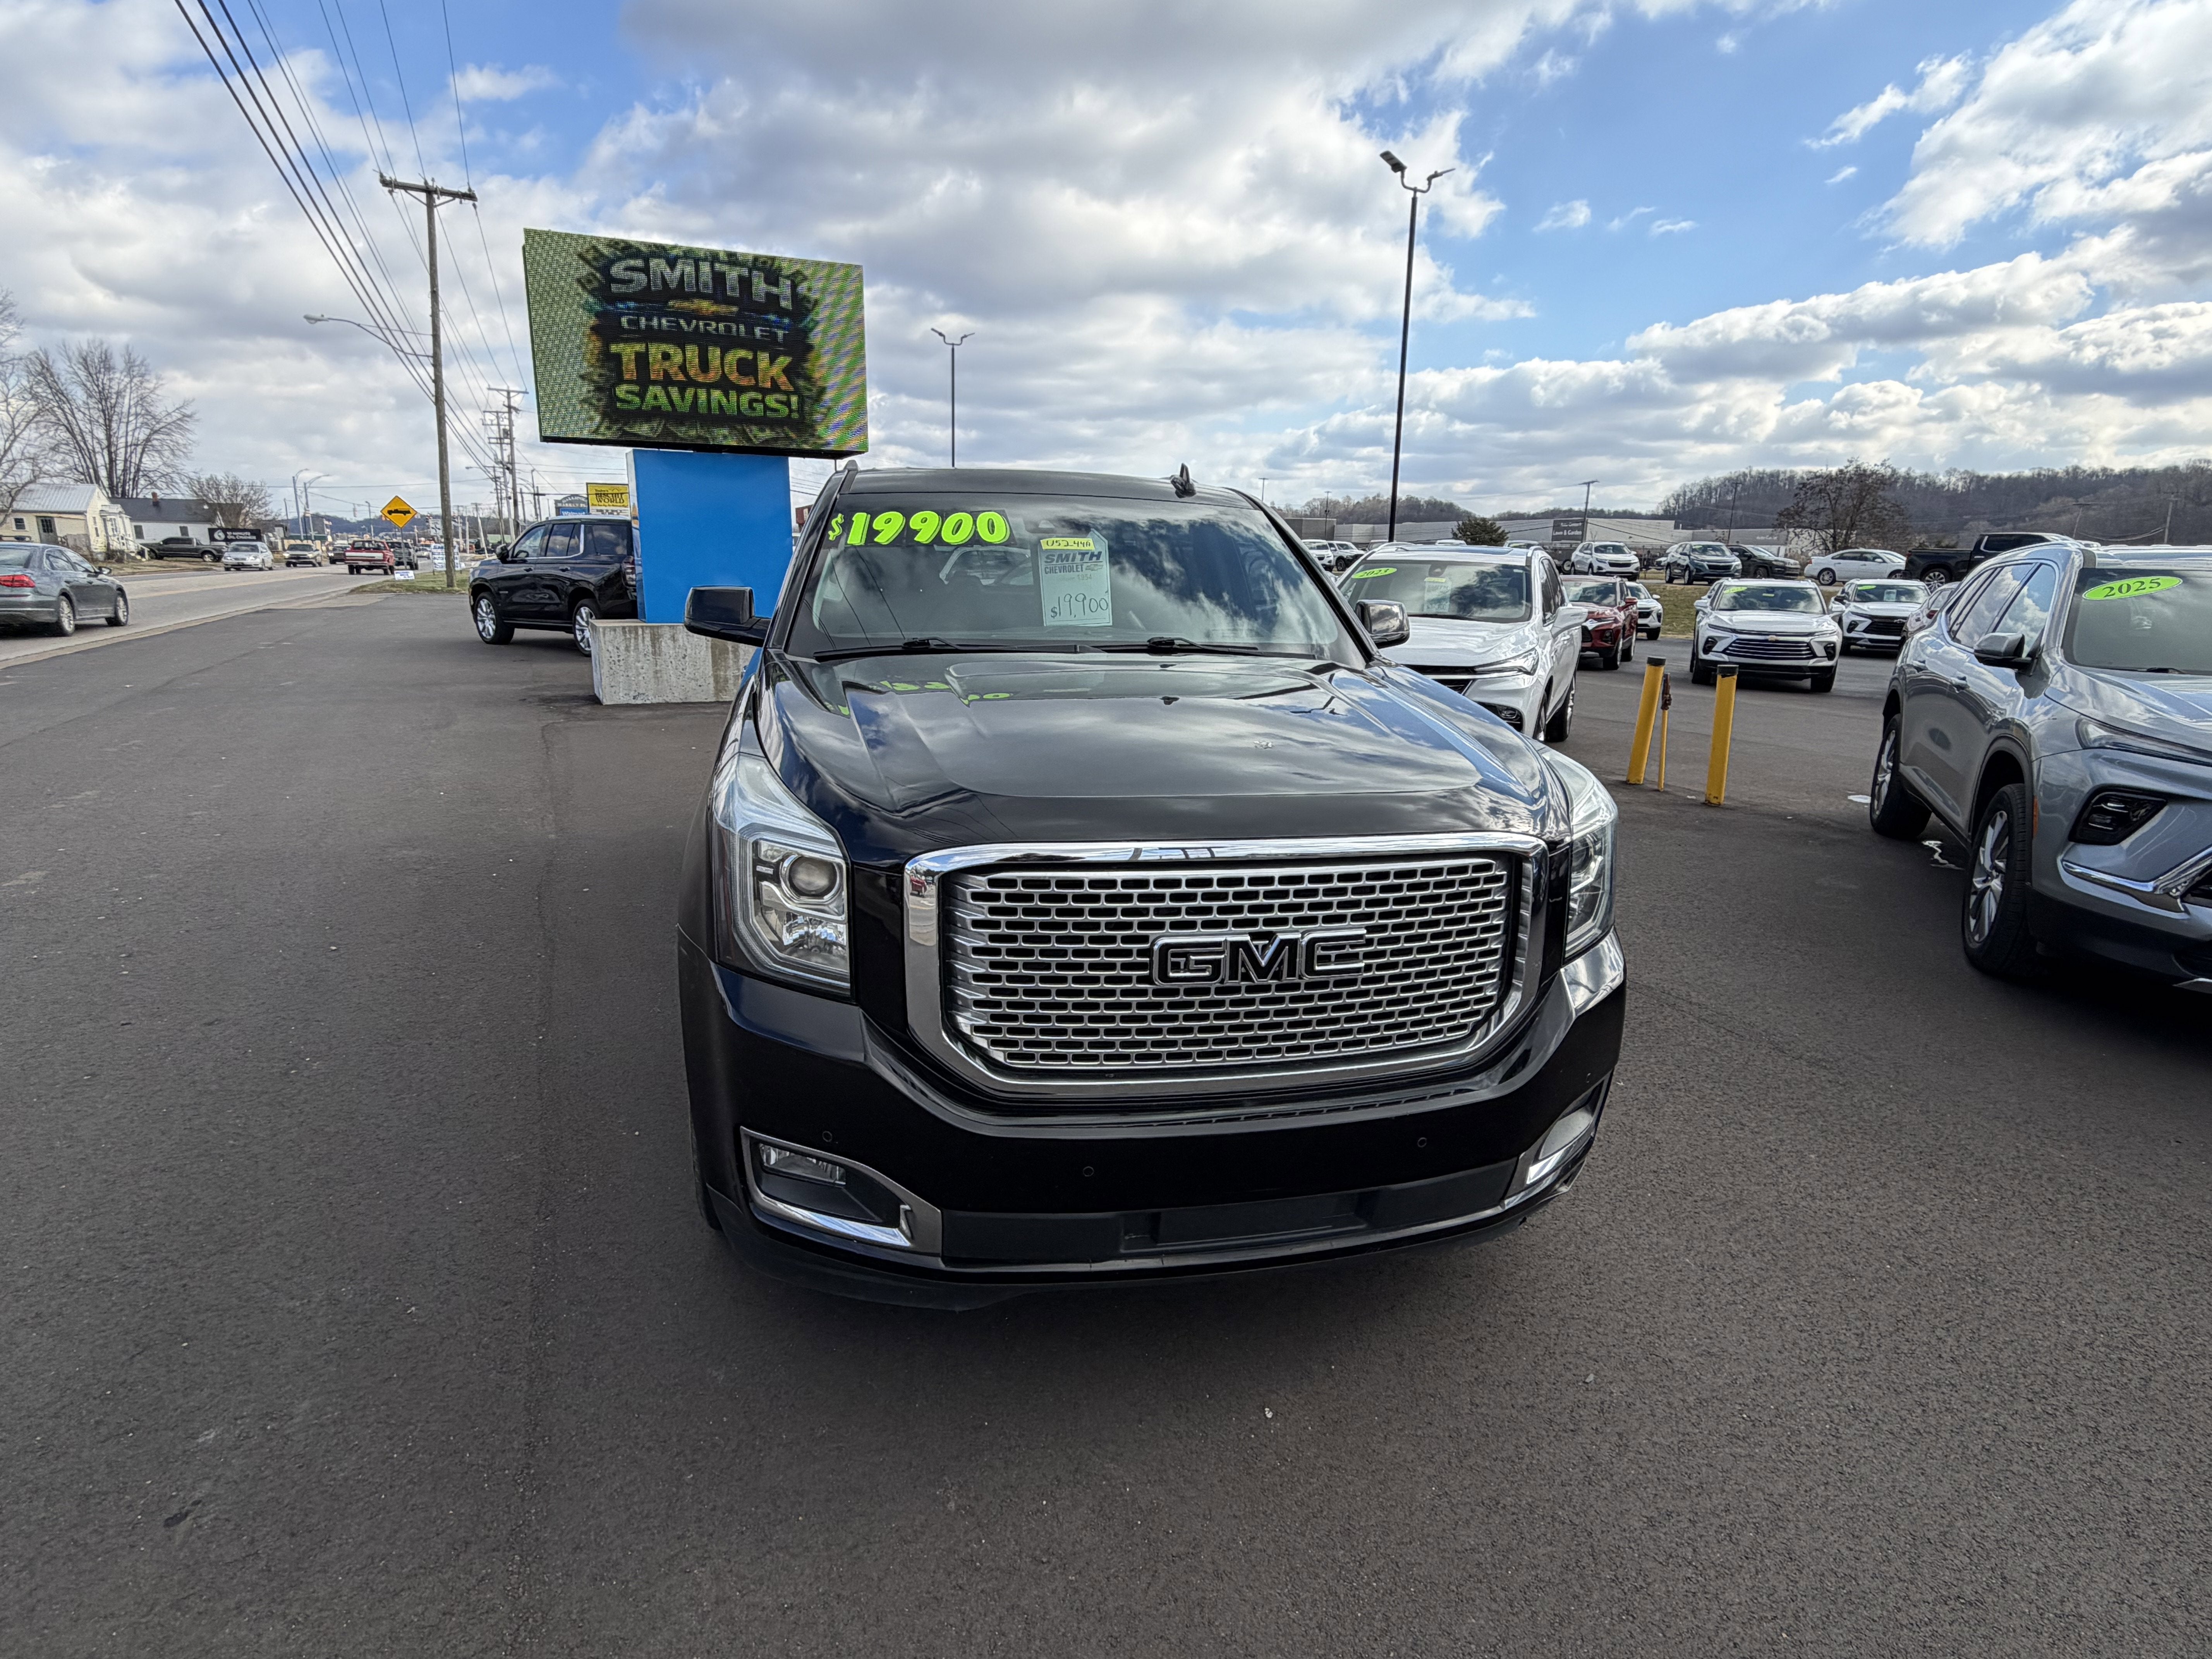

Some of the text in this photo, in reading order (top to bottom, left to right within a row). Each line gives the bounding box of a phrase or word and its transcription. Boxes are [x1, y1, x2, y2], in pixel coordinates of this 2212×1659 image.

[610, 258, 792, 310] SMITH
[620, 315, 788, 343] CHEVROLET
[610, 342, 794, 391] TRUCK
[616, 385, 800, 419] SAVINGS!
[828, 510, 1010, 545] $19900
[1044, 551, 1102, 563] SMITH
[1044, 564, 1084, 574] CHEVROLET
[2103, 578, 2161, 598] 2025
[1051, 593, 1108, 618] $19,900
[1152, 929, 1367, 986] GMC
